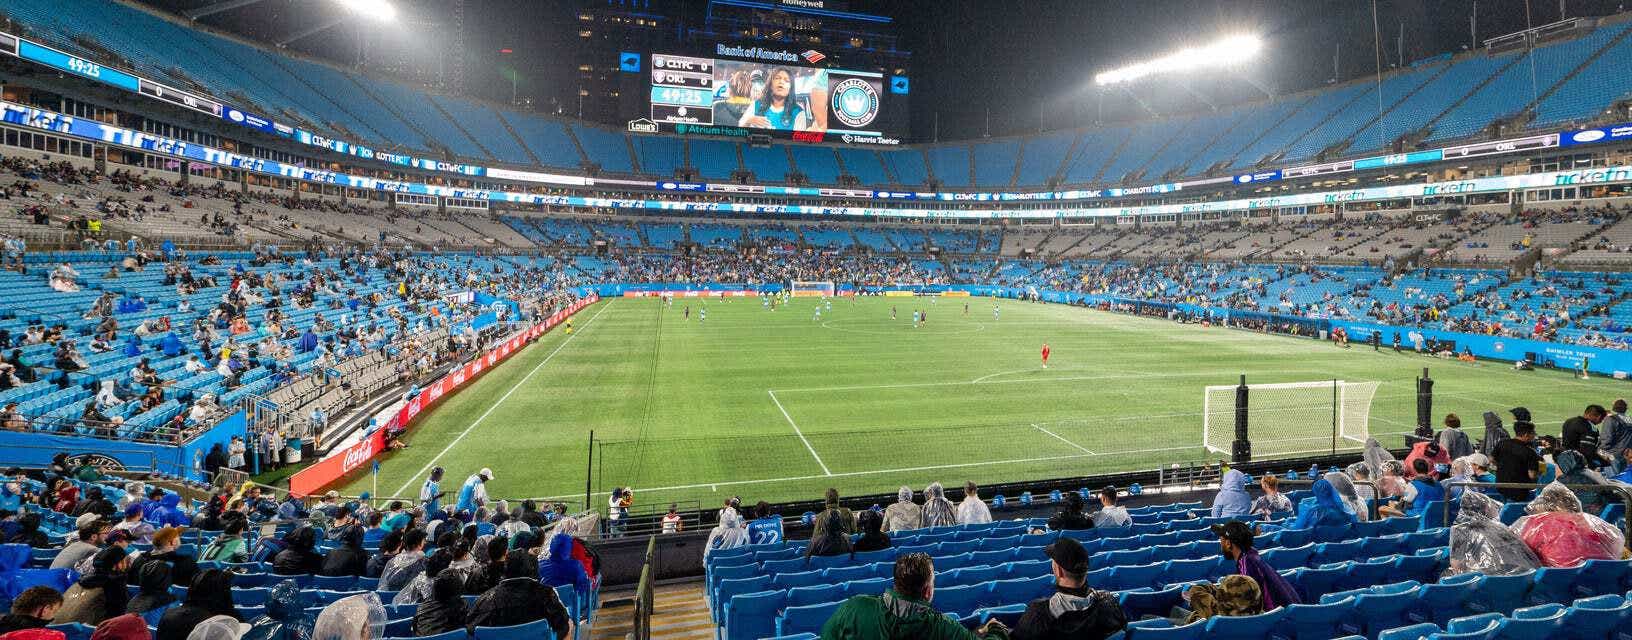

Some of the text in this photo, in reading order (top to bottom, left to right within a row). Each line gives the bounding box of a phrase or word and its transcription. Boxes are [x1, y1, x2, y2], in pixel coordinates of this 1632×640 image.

[717, 43, 799, 62] Bank of America
[67, 57, 101, 78] 49:25
[666, 59, 708, 71] CLTFC 0
[666, 73, 708, 86] ORL 0
[836, 79, 873, 96] CHARLOTTE
[155, 86, 198, 108] 0 ORL
[662, 89, 703, 103] 49:25
[688, 125, 749, 137] Atrium Health
[854, 135, 900, 146] Harris Teeter
[1546, 347, 1573, 356] DAIMLER
[343, 438, 373, 472] Coca-Cola
